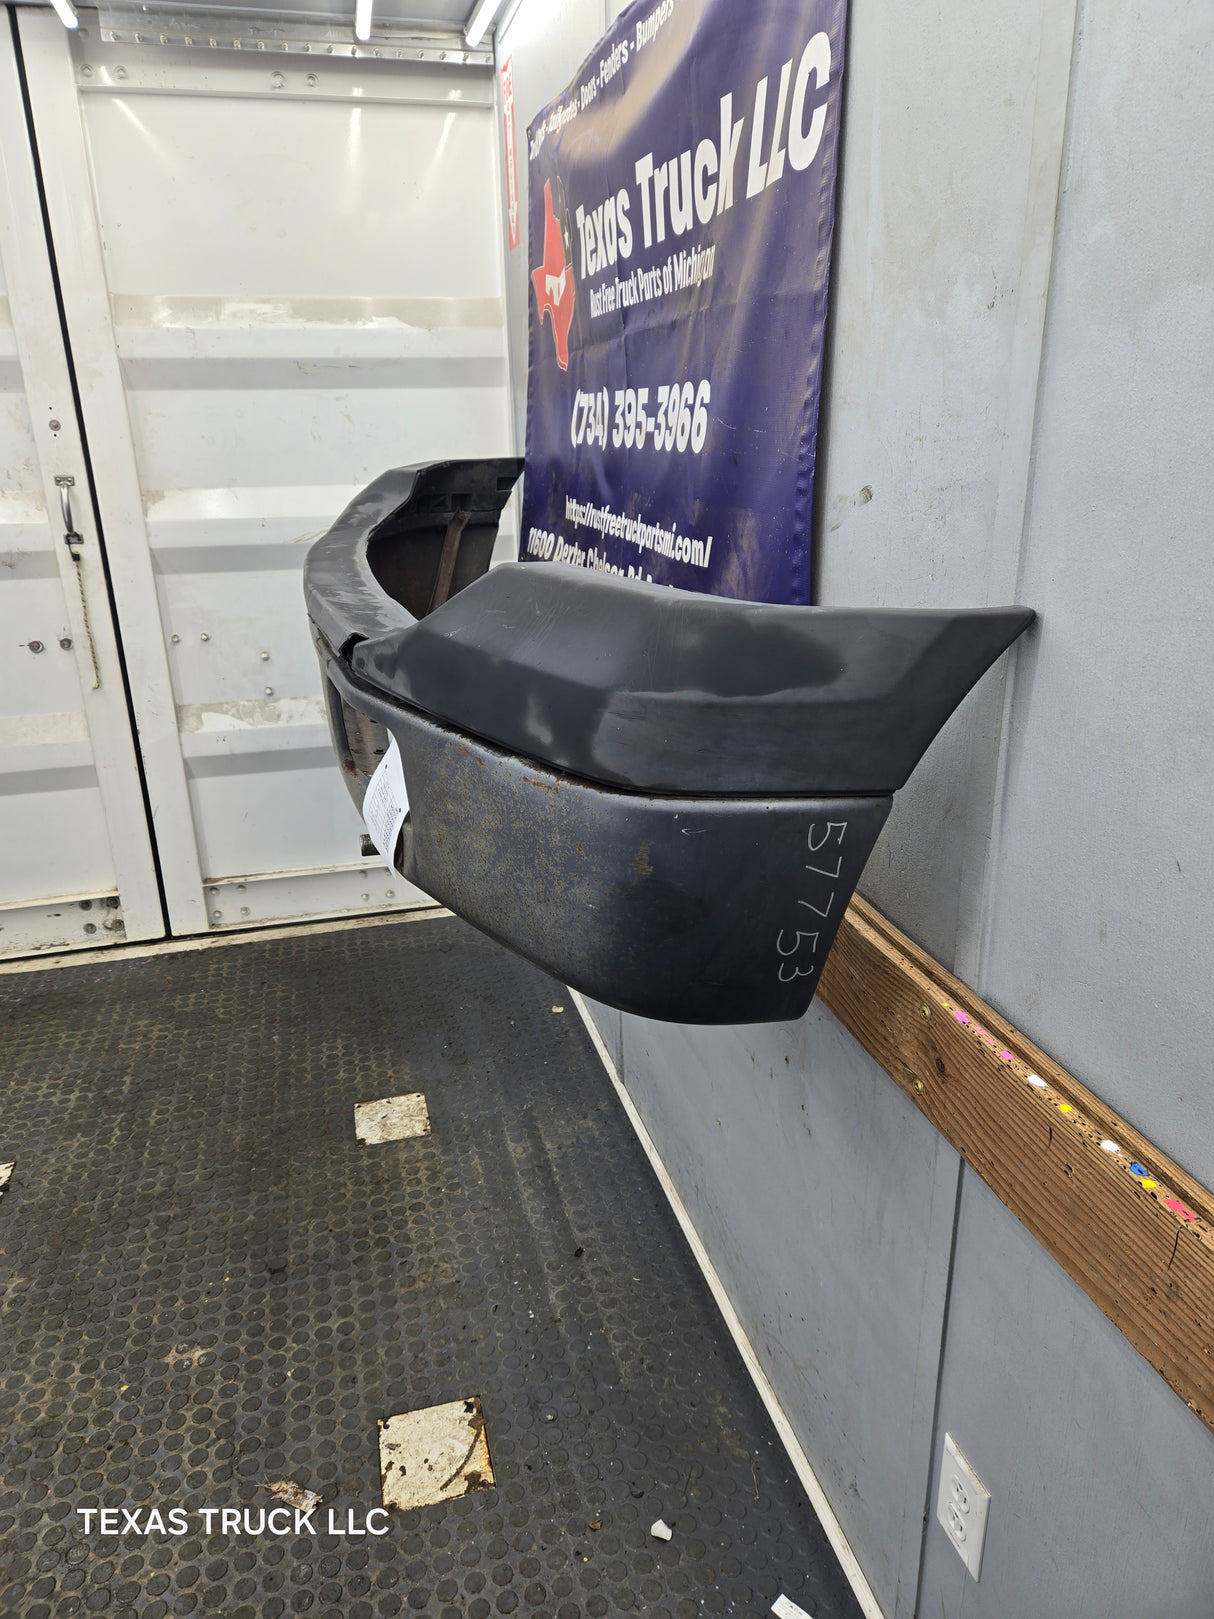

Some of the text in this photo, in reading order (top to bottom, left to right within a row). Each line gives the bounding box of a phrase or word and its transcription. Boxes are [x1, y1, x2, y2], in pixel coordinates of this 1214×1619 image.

[580, 75, 598, 111] Doors
[600, 39, 629, 88] Fenders
[636, 0, 674, 53] Bumpers
[575, 188, 633, 280] Texas
[635, 92, 745, 249] Truck
[746, 31, 832, 199] LLC
[590, 244, 716, 318] Rust Free Truck Parts of Michigan
[571, 379, 711, 454] (734) 395-3966
[526, 527, 556, 561] 11600
[552, 535, 586, 568] Dexter
[565, 494, 713, 568] https://rustfreetruckpartsmi.com/
[777, 821, 848, 982] 57753
